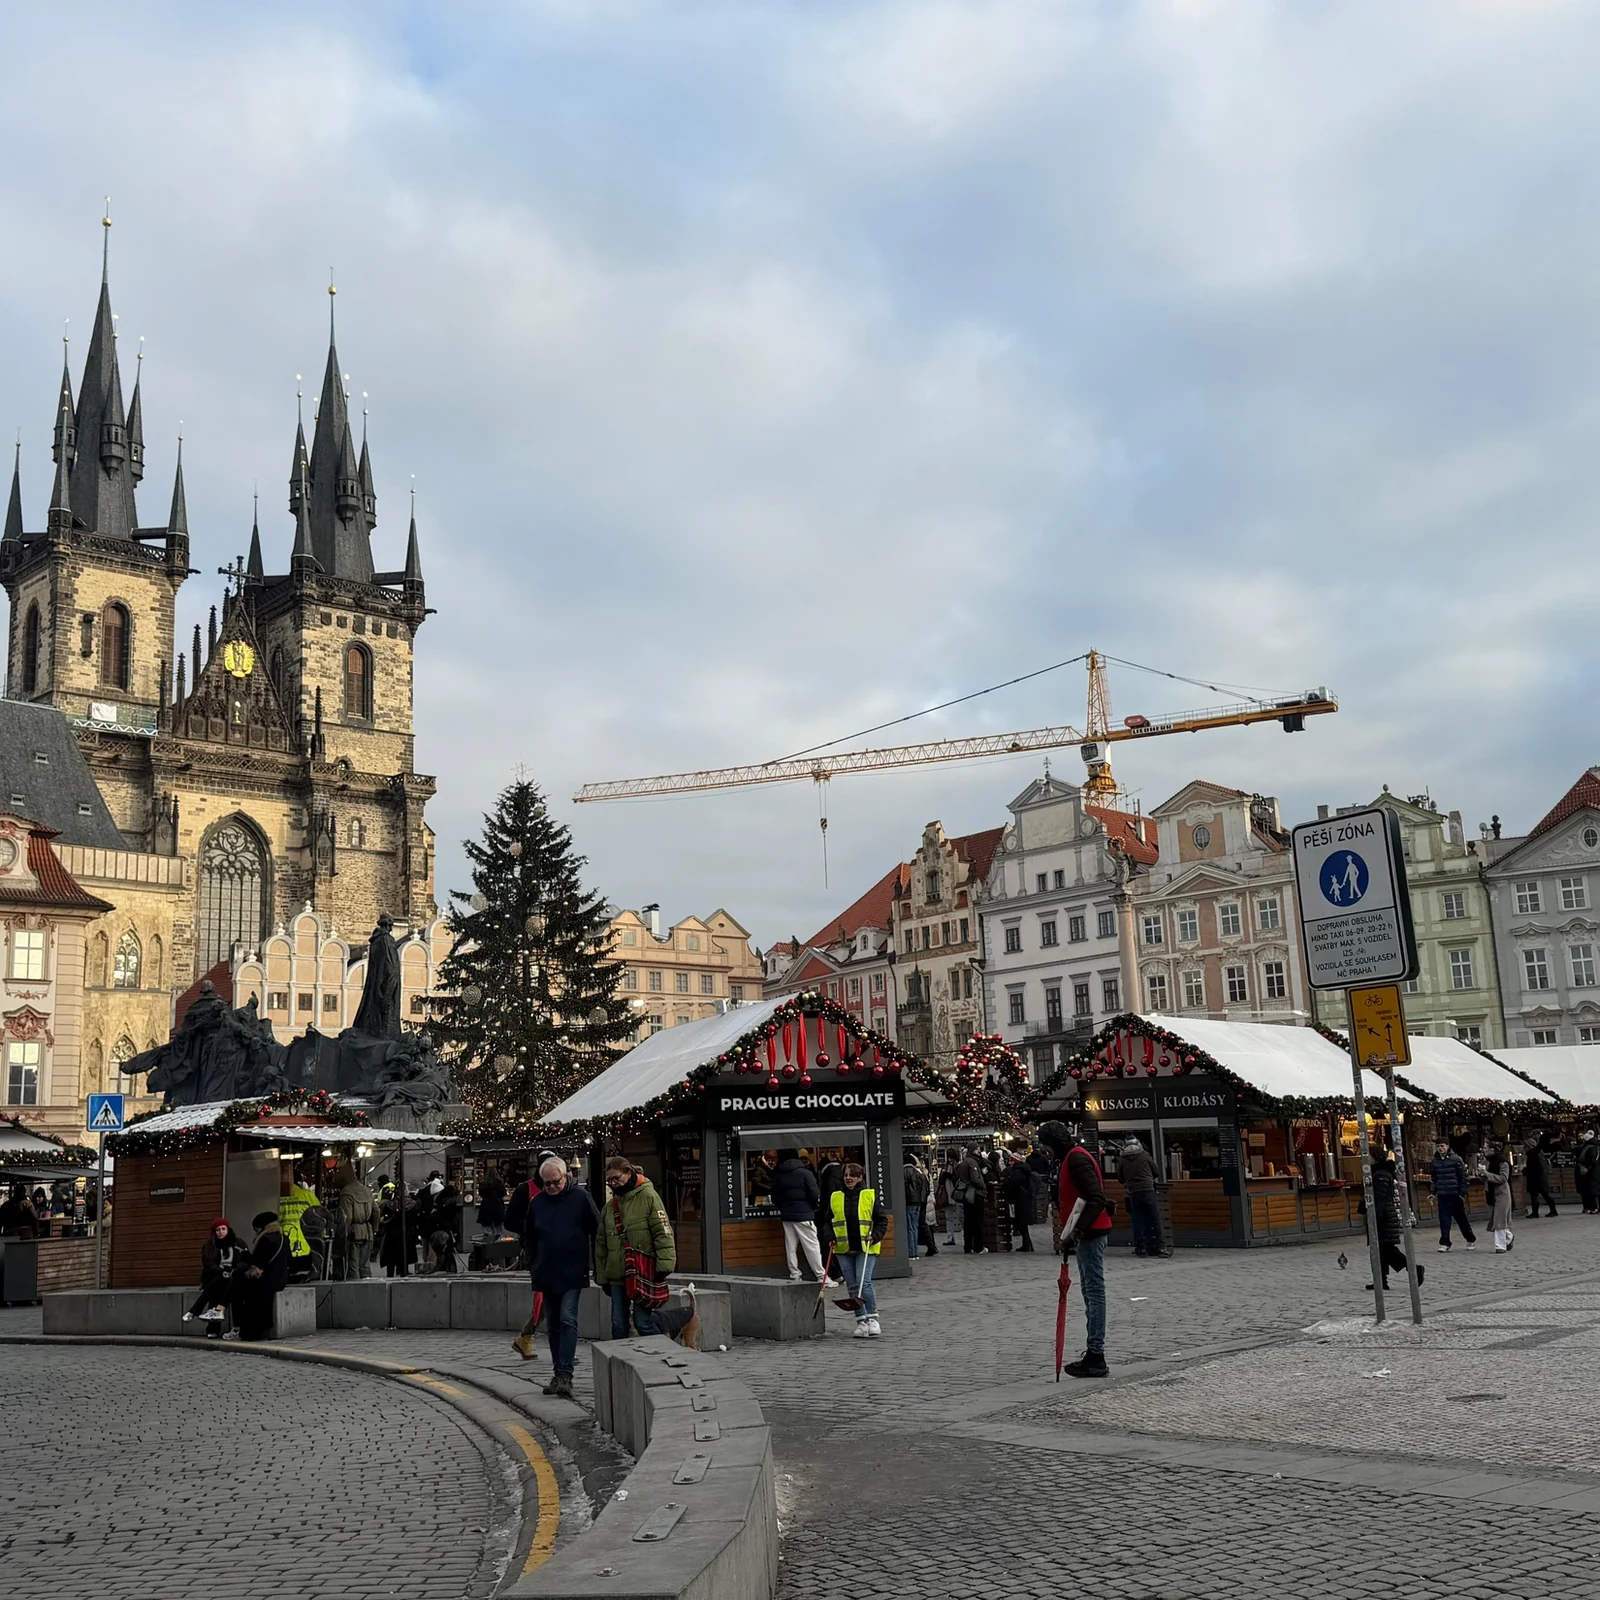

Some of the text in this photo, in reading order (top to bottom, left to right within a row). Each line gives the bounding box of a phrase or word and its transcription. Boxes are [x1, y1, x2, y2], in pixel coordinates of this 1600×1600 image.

[1303, 822, 1375, 849] PĚŠÍ ZÓNA
[1317, 914, 1383, 932] DOPRAVNÍ OBSLUHA
[1311, 933, 1328, 943] MIMO
[1330, 930, 1344, 940] TAXI
[1367, 923, 1386, 933] 20-22
[1314, 942, 1338, 952] SVATBY
[1358, 937, 1362, 945] 5
[1363, 933, 1392, 943] VOZIDEL
[1315, 952, 1397, 971] VOZIDLA SE SOUHLASEM
[1349, 966, 1372, 976] PRAHA
[720, 1092, 894, 1111] PRAGUE CHOCOLATE
[1085, 1092, 1226, 1111] SAUSAGES KLOBÁSY
